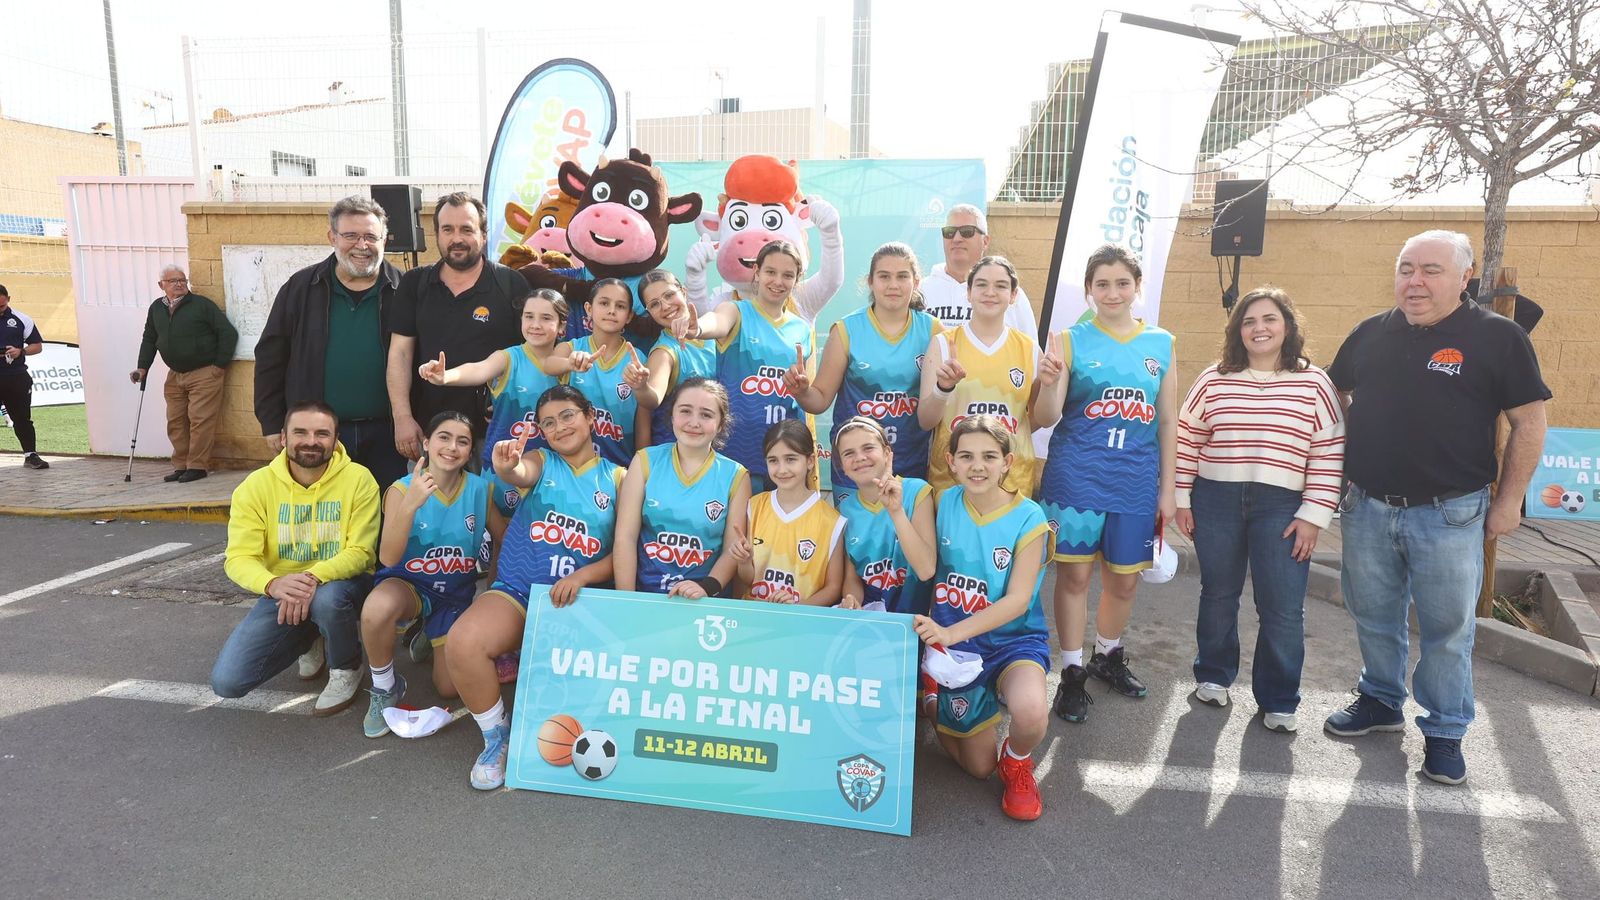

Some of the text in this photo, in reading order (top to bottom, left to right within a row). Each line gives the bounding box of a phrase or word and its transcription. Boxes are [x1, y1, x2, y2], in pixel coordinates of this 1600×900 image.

[1103, 388, 1145, 402] COPA
[764, 404, 786, 424] 10
[967, 402, 1009, 416] COPA
[1084, 400, 1155, 423] COVAP
[1107, 427, 1127, 449] 11
[1542, 455, 1592, 469] VALE
[1577, 472, 1590, 484] A
[547, 511, 586, 535] COPA
[530, 521, 600, 556] COVAP
[658, 533, 701, 550] COPA
[425, 547, 462, 559] COPA
[405, 557, 476, 574] COVAP
[549, 555, 576, 578] 16
[764, 569, 795, 587] OPA
[948, 574, 988, 597] COPA
[935, 583, 992, 614] COVA
[694, 615, 738, 651] 13 ED
[551, 648, 882, 708] VALE POR UN PASE
[608, 687, 811, 735] A LA FINAL
[643, 735, 768, 764] 11-12 ABRIL
[846, 767, 876, 777] COVAP
